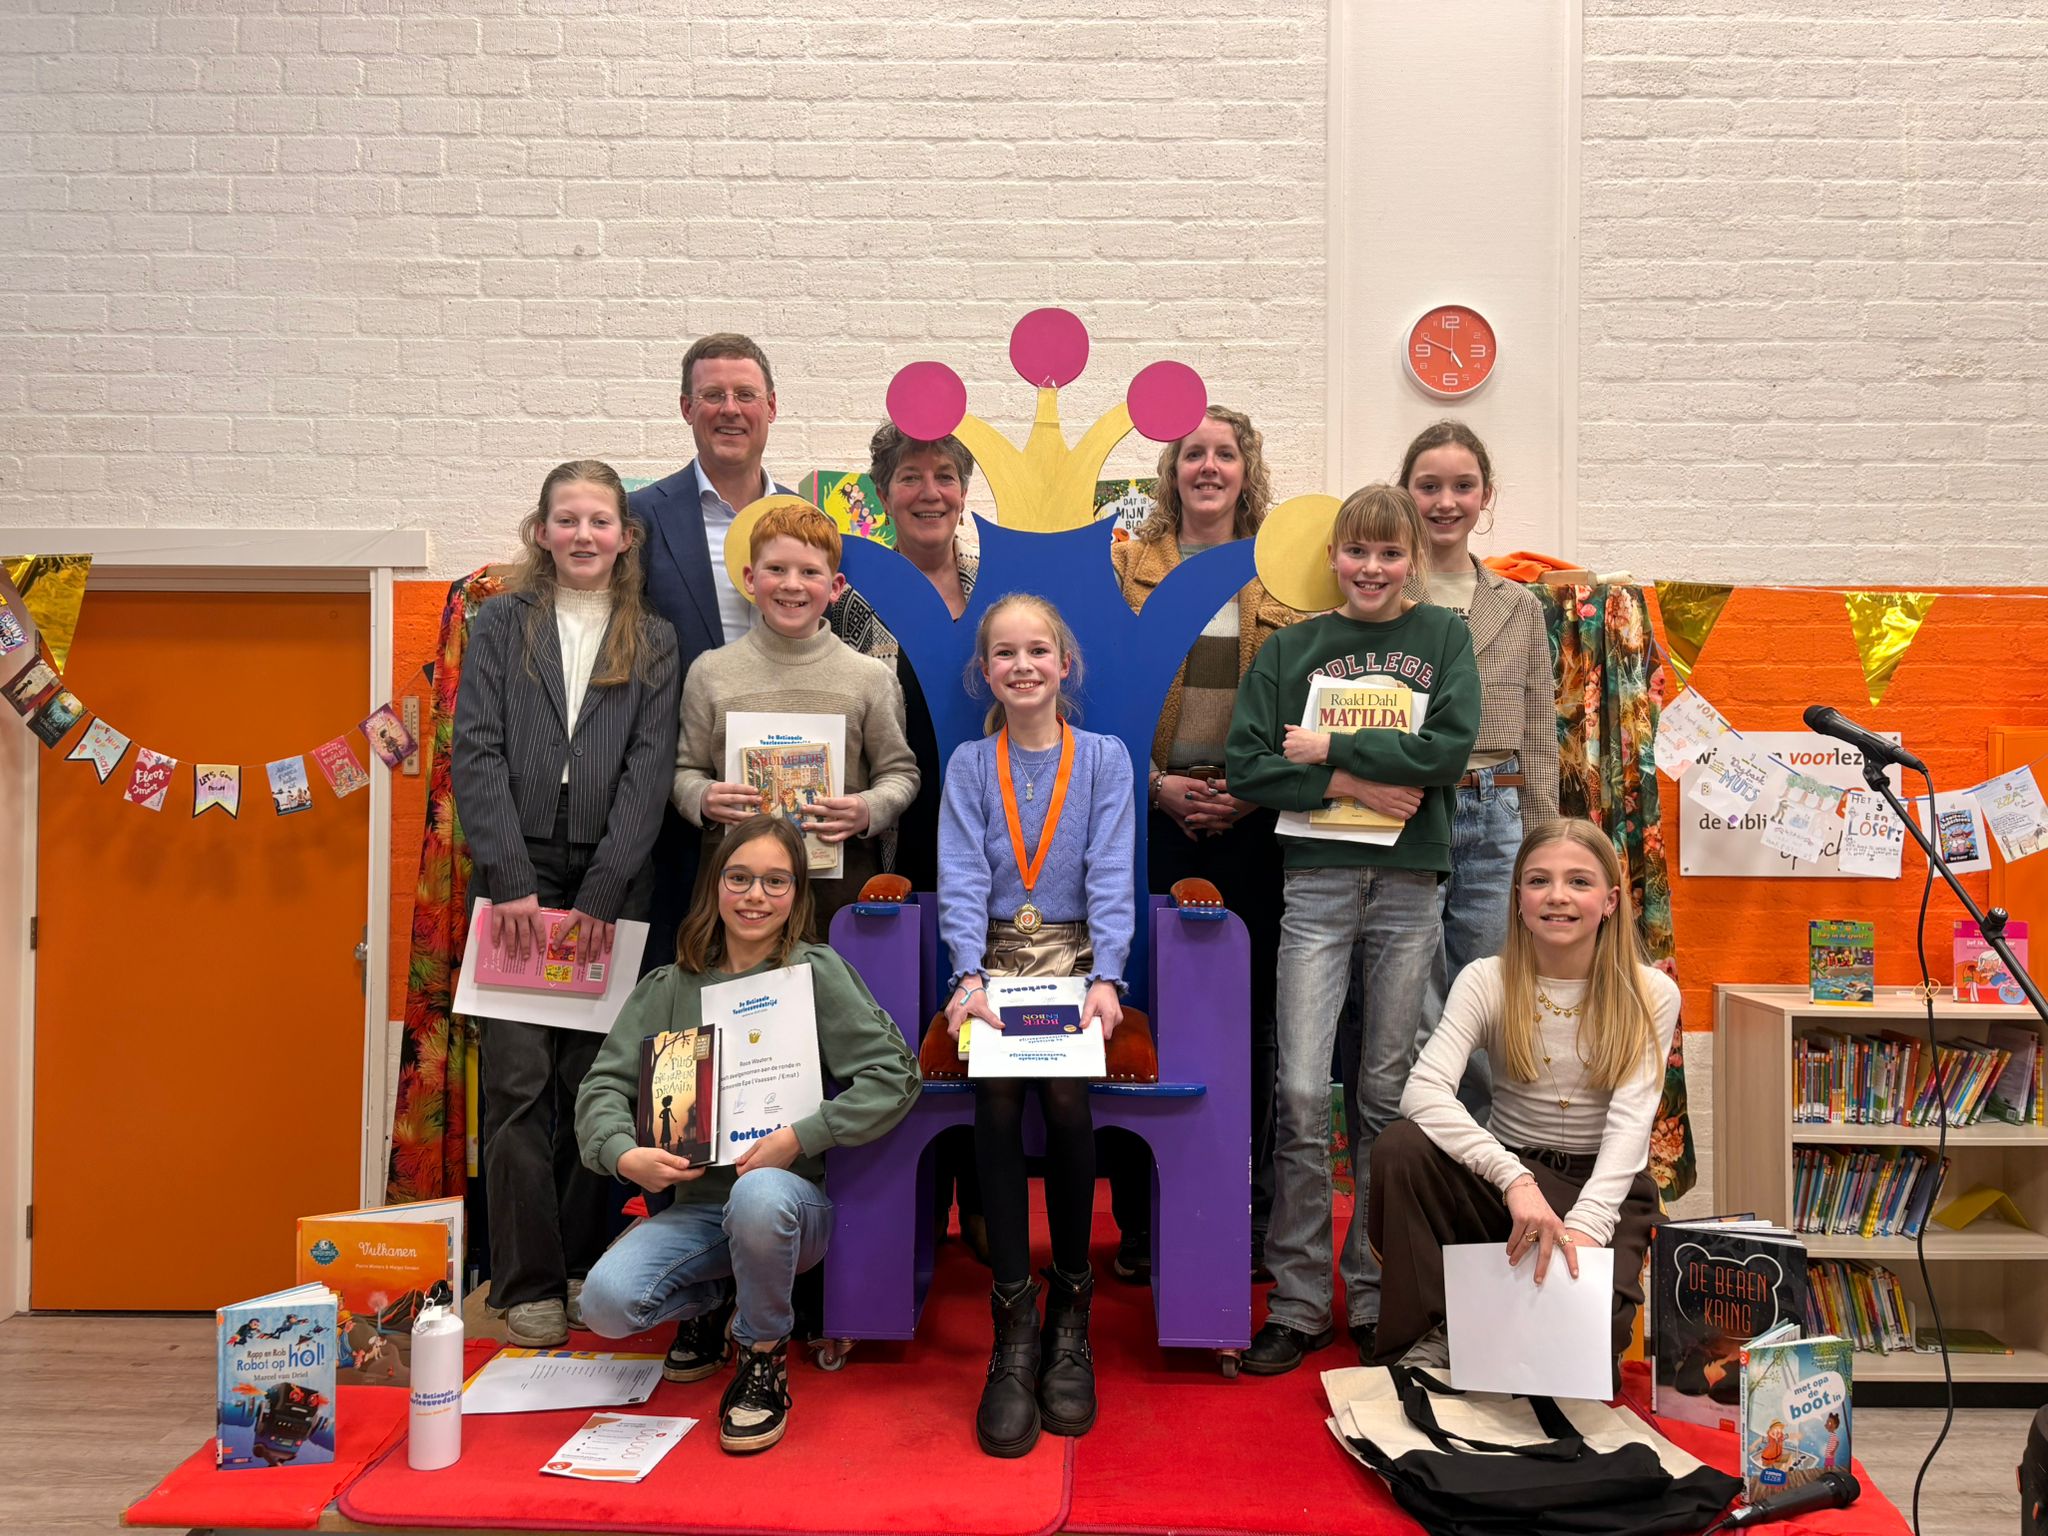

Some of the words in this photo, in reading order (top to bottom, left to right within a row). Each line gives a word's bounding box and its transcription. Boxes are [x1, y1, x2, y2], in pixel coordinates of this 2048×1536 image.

[1442, 315, 1460, 329] 12
[1415, 344, 1431, 357] 9
[1470, 344, 1486, 357] 3
[1443, 373, 1458, 386] 6
[1123, 498, 1137, 507] DAT
[1116, 506, 1144, 519] MIJN
[1307, 652, 1433, 689] COLLEGE
[1331, 693, 1365, 706] Roald
[1368, 694, 1397, 706] Dahl
[1319, 708, 1408, 728] MATILDA
[1789, 747, 1863, 766] voorlez
[1719, 769, 1761, 802] MUTS
[1699, 813, 1721, 830] de
[1000, 984, 1057, 994] Oorkonde
[730, 1123, 788, 1142] Oorkon
[358, 1241, 417, 1258] Vulkanen
[1689, 1262, 1709, 1293] DE
[1715, 1265, 1767, 1303] BEREN
[1704, 1297, 1751, 1332] KRING
[273, 1348, 286, 1357] Rob
[236, 1359, 268, 1371] Robot
[271, 1360, 285, 1371] op
[254, 1373, 276, 1381] Marcel
[1793, 1384, 1811, 1396] met
[1813, 1375, 1829, 1388] opa
[1807, 1388, 1819, 1399] de
[1789, 1391, 1831, 1420] boot
[1832, 1393, 1842, 1402] in
